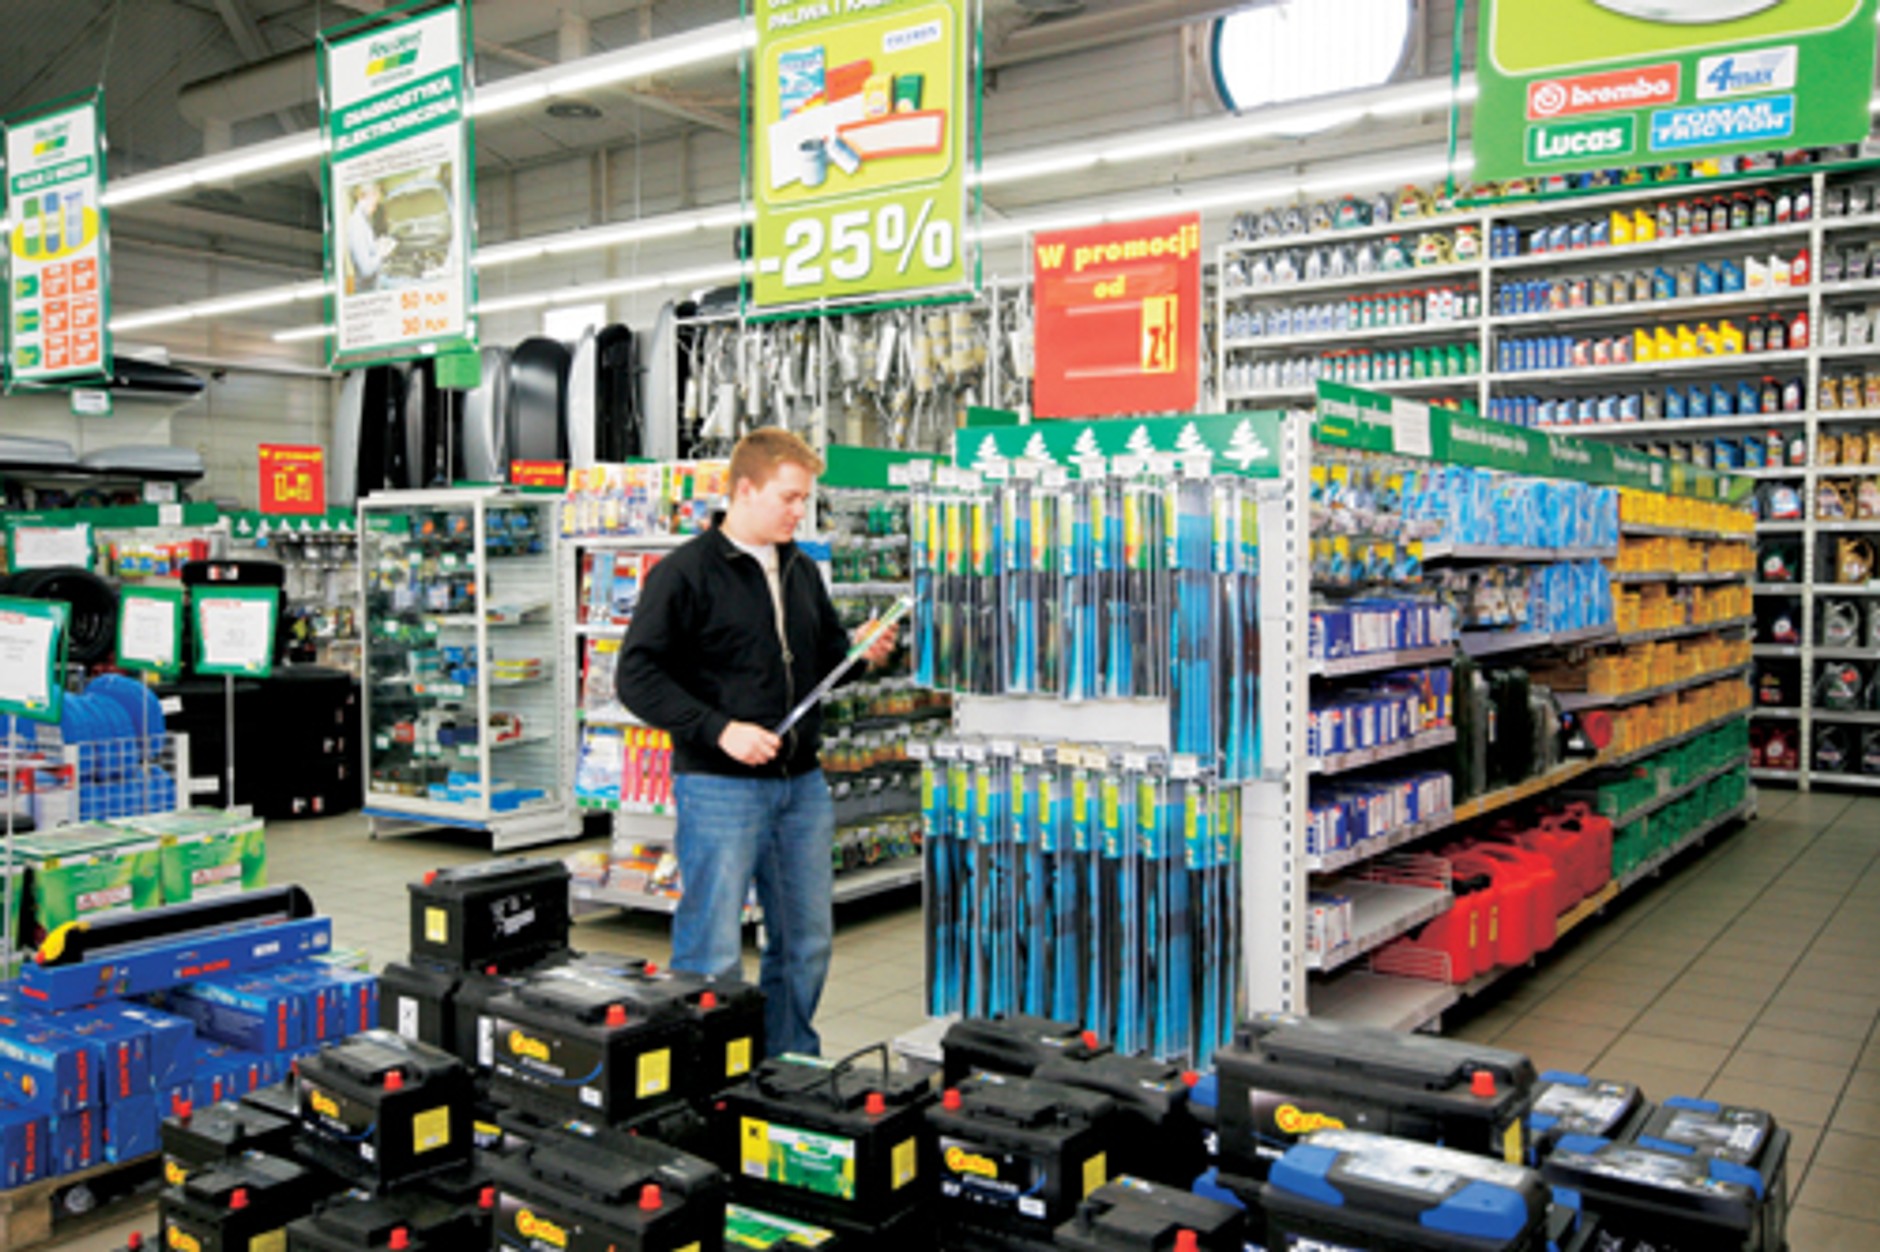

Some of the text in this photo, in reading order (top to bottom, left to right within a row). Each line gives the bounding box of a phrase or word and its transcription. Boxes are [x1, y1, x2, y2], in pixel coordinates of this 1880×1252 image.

[1571, 78, 1671, 105] brembo
[1535, 127, 1623, 158] Lucas
[1657, 116, 1787, 142] FRICTION
[759, 198, 953, 287] -25%
[1037, 223, 1198, 272] W promocji
[1093, 274, 1126, 299] od
